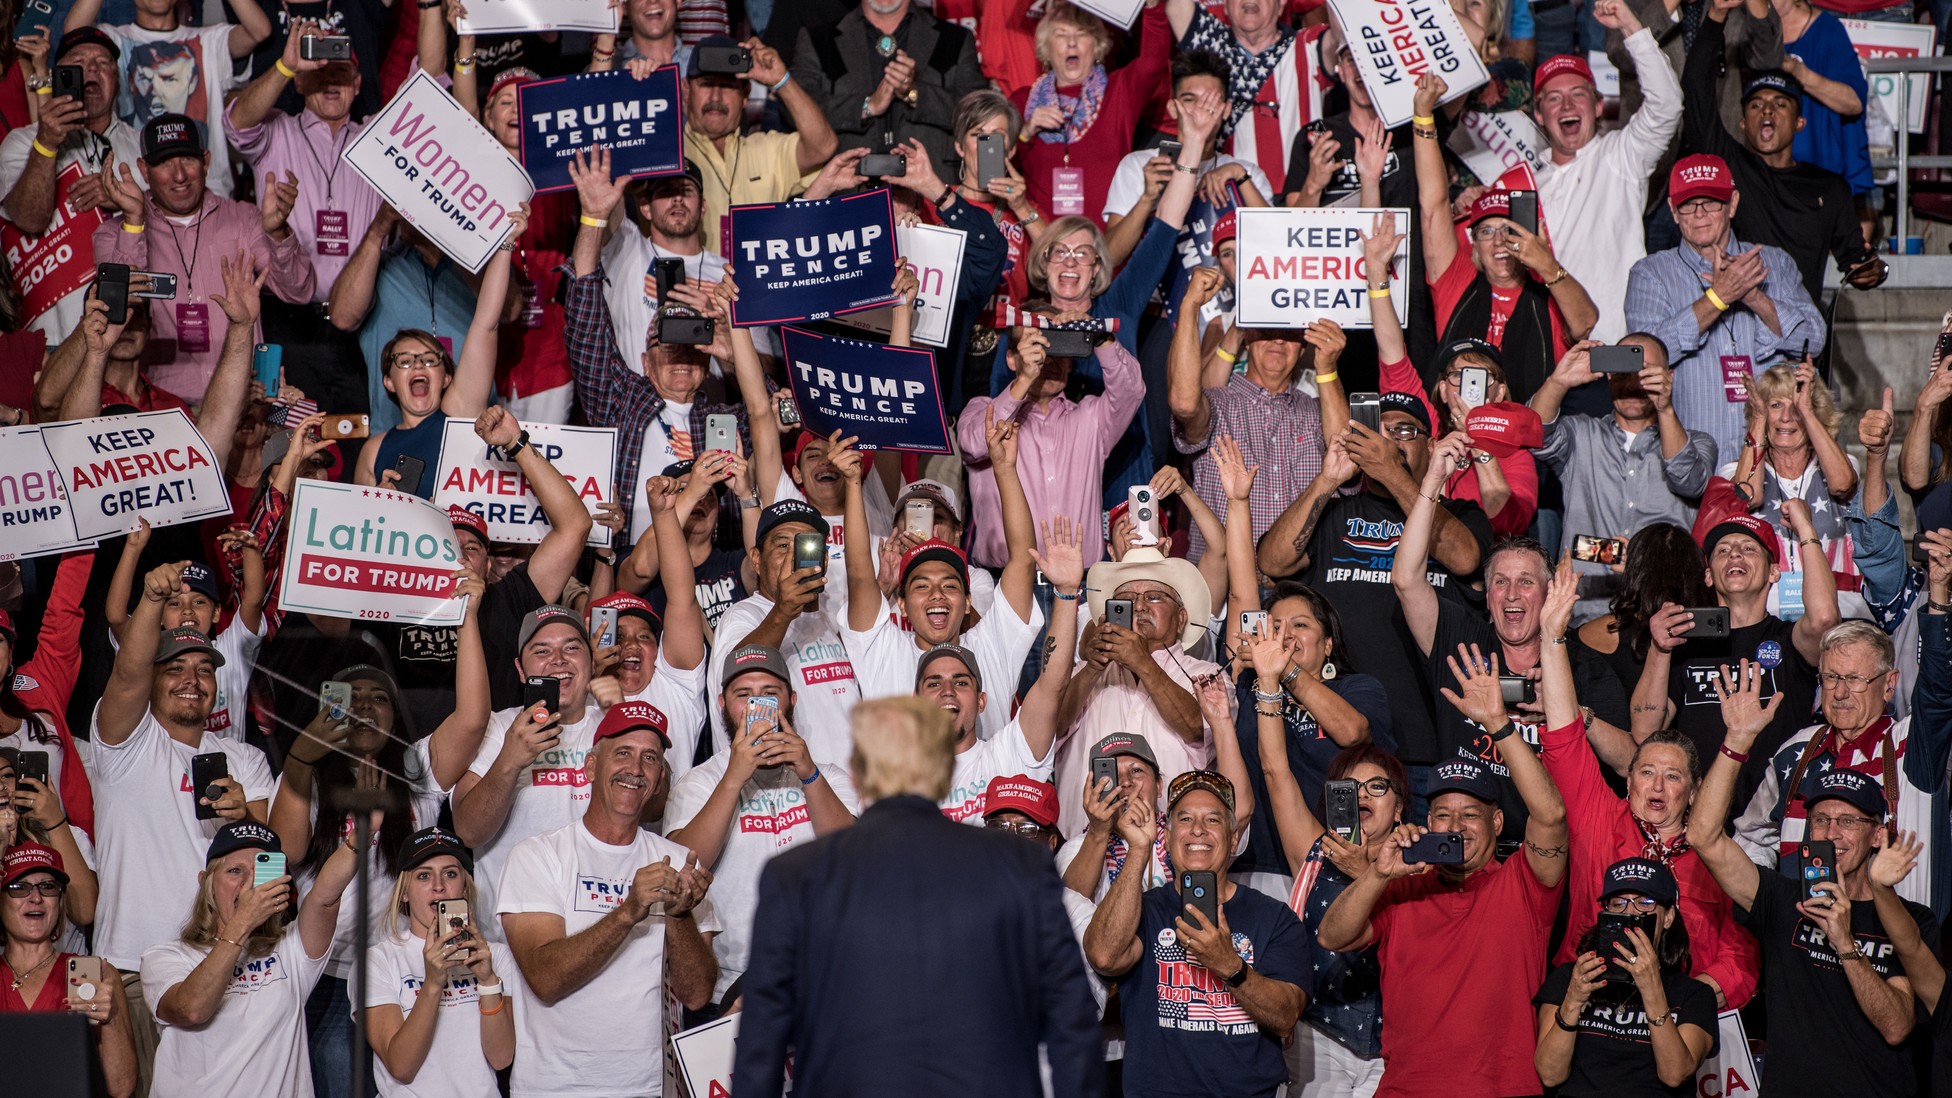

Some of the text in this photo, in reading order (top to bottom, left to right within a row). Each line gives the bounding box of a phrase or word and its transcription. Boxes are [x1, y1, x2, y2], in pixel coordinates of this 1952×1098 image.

[1375, 0, 1429, 86] MERIC
[1361, 25, 1402, 85] KEEP
[532, 98, 669, 134] TRUMP
[156, 123, 186, 135] TRUMP
[546, 121, 656, 149] PENCE
[157, 132, 179, 143] PENCE
[1460, 111, 1521, 170] ome
[556, 147, 577, 157] KEEP
[615, 139, 646, 151] GREAT!
[1516, 139, 1543, 172] FOR
[388, 101, 506, 231] Women
[1680, 166, 1719, 177] TRUMP
[384, 145, 477, 243] FOR TRUMP
[400, 207, 416, 223] 2020
[741, 224, 882, 262] TRUMP
[1287, 227, 1361, 249] KEEP
[23, 246, 49, 267] AMERICA
[49, 227, 72, 248] GREAT!
[20, 243, 73, 297] 2020
[755, 250, 873, 279] PENCE
[767, 269, 863, 290] KEEP AMERICA GREAT!
[810, 311, 829, 320] 2020
[852, 322, 871, 330] 2020
[795, 360, 925, 399] TRUMP
[809, 387, 917, 414] PENCE
[819, 406, 908, 424] KEEP AMERICA GREAT!
[1480, 416, 1509, 425] AMERICA
[1484, 424, 1505, 432] AGAIN
[87, 427, 155, 454] KEEP
[73, 445, 209, 493] AMERICA
[100, 478, 196, 517] GREAT!
[2, 504, 62, 527] RUMP
[771, 502, 814, 514] TRUMP
[306, 507, 458, 563] Latinos
[0, 553, 15, 561] 020
[911, 545, 928, 556] MAKE
[1370, 556, 1393, 569] 202
[307, 561, 451, 592] FOR TRUMP
[1326, 568, 1352, 583] KEEP
[1352, 569, 1393, 584] AMERI
[359, 609, 390, 619] 2020
[735, 648, 767, 659] Latinos
[736, 655, 748, 663] FOR
[14, 675, 25, 690] USA
[806, 667, 828, 682] FOR
[620, 706, 663, 722] TRUMP
[1101, 735, 1132, 748] Latinos
[538, 771, 568, 783] FOR
[1437, 764, 1482, 774] TRUMP
[1440, 769, 1478, 778] PENCE
[1820, 773, 1866, 785] TRUMP
[1823, 779, 1861, 790] PENCE
[1014, 784, 1043, 797] AMERICA
[1018, 791, 1040, 803] AGAIN
[739, 788, 802, 813] Latino
[745, 808, 808, 831] FOR TRUM
[230, 825, 275, 839] TRUMP
[415, 834, 436, 845] SPACE
[5, 850, 53, 861] MAKE AMERICA
[10, 856, 52, 866] GREAT AGAIN
[1611, 864, 1656, 876] TRUMP
[1614, 870, 1652, 879] PENCE
[1809, 949, 1837, 966] MERICA
[1156, 984, 1191, 1003] 2020
[1158, 1016, 1176, 1028] MAKE
[1176, 1018, 1215, 1032] LIBERALS
[1231, 1022, 1259, 1036] AGAIN
[1591, 1021, 1626, 1037] AMERICA
[1627, 1027, 1651, 1038] GREAT
